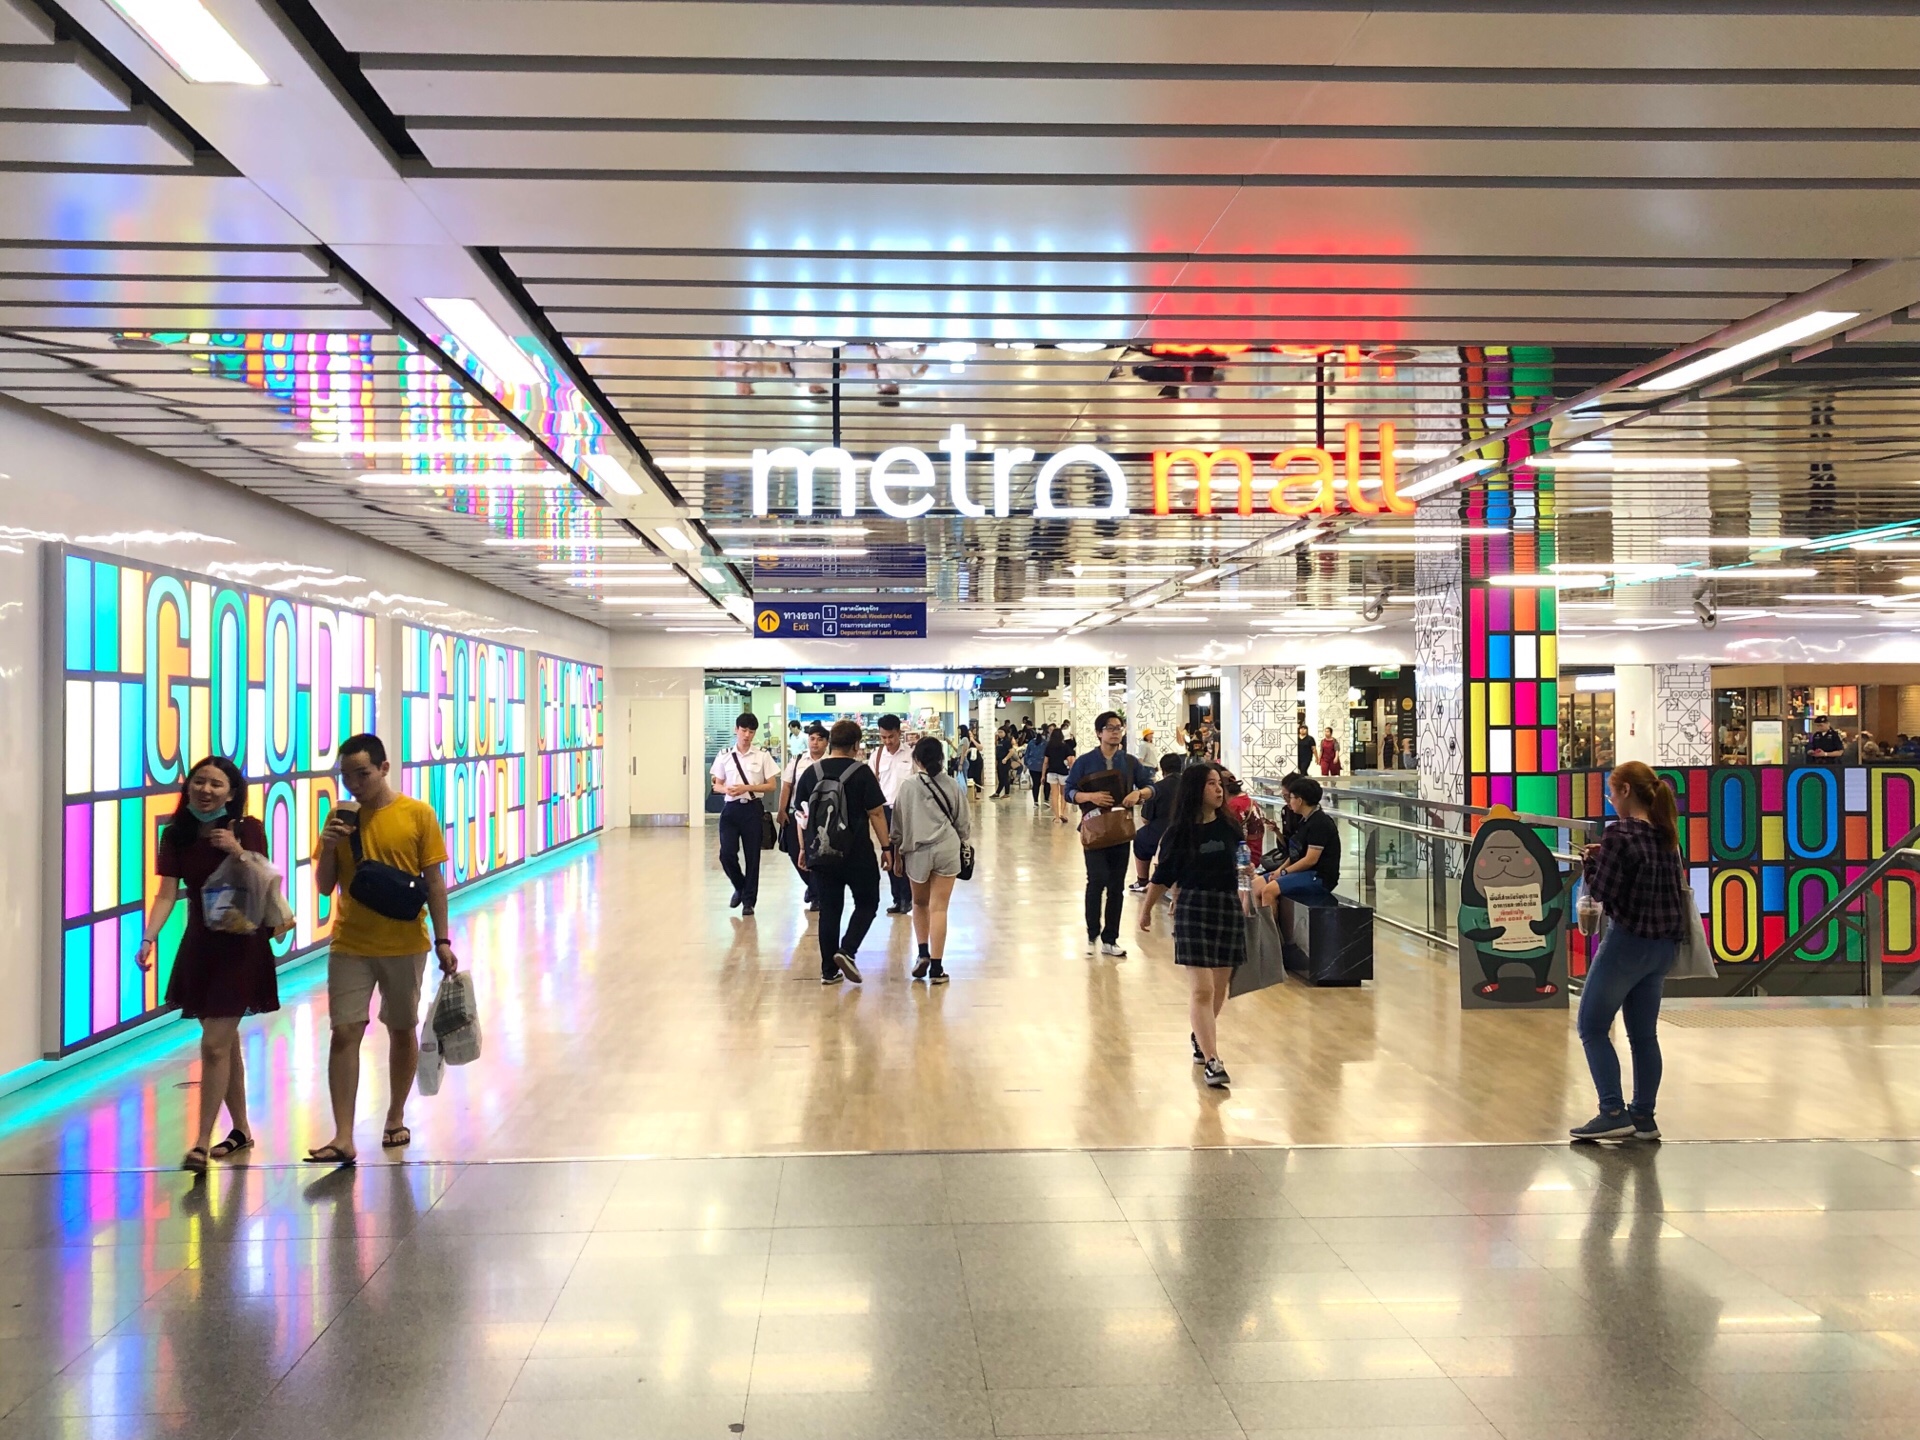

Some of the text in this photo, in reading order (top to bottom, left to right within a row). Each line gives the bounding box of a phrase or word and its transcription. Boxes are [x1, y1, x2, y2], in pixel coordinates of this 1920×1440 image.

[752, 421, 1417, 518] metro mall
[783, 611, 821, 620] ทางออก
[793, 622, 810, 631] Exit
[145, 575, 340, 785] GOOD
[429, 632, 509, 761] GOOD
[537, 655, 603, 752] CHOOSE
[145, 776, 339, 1014] FOD
[1711, 867, 1920, 963] OOD
